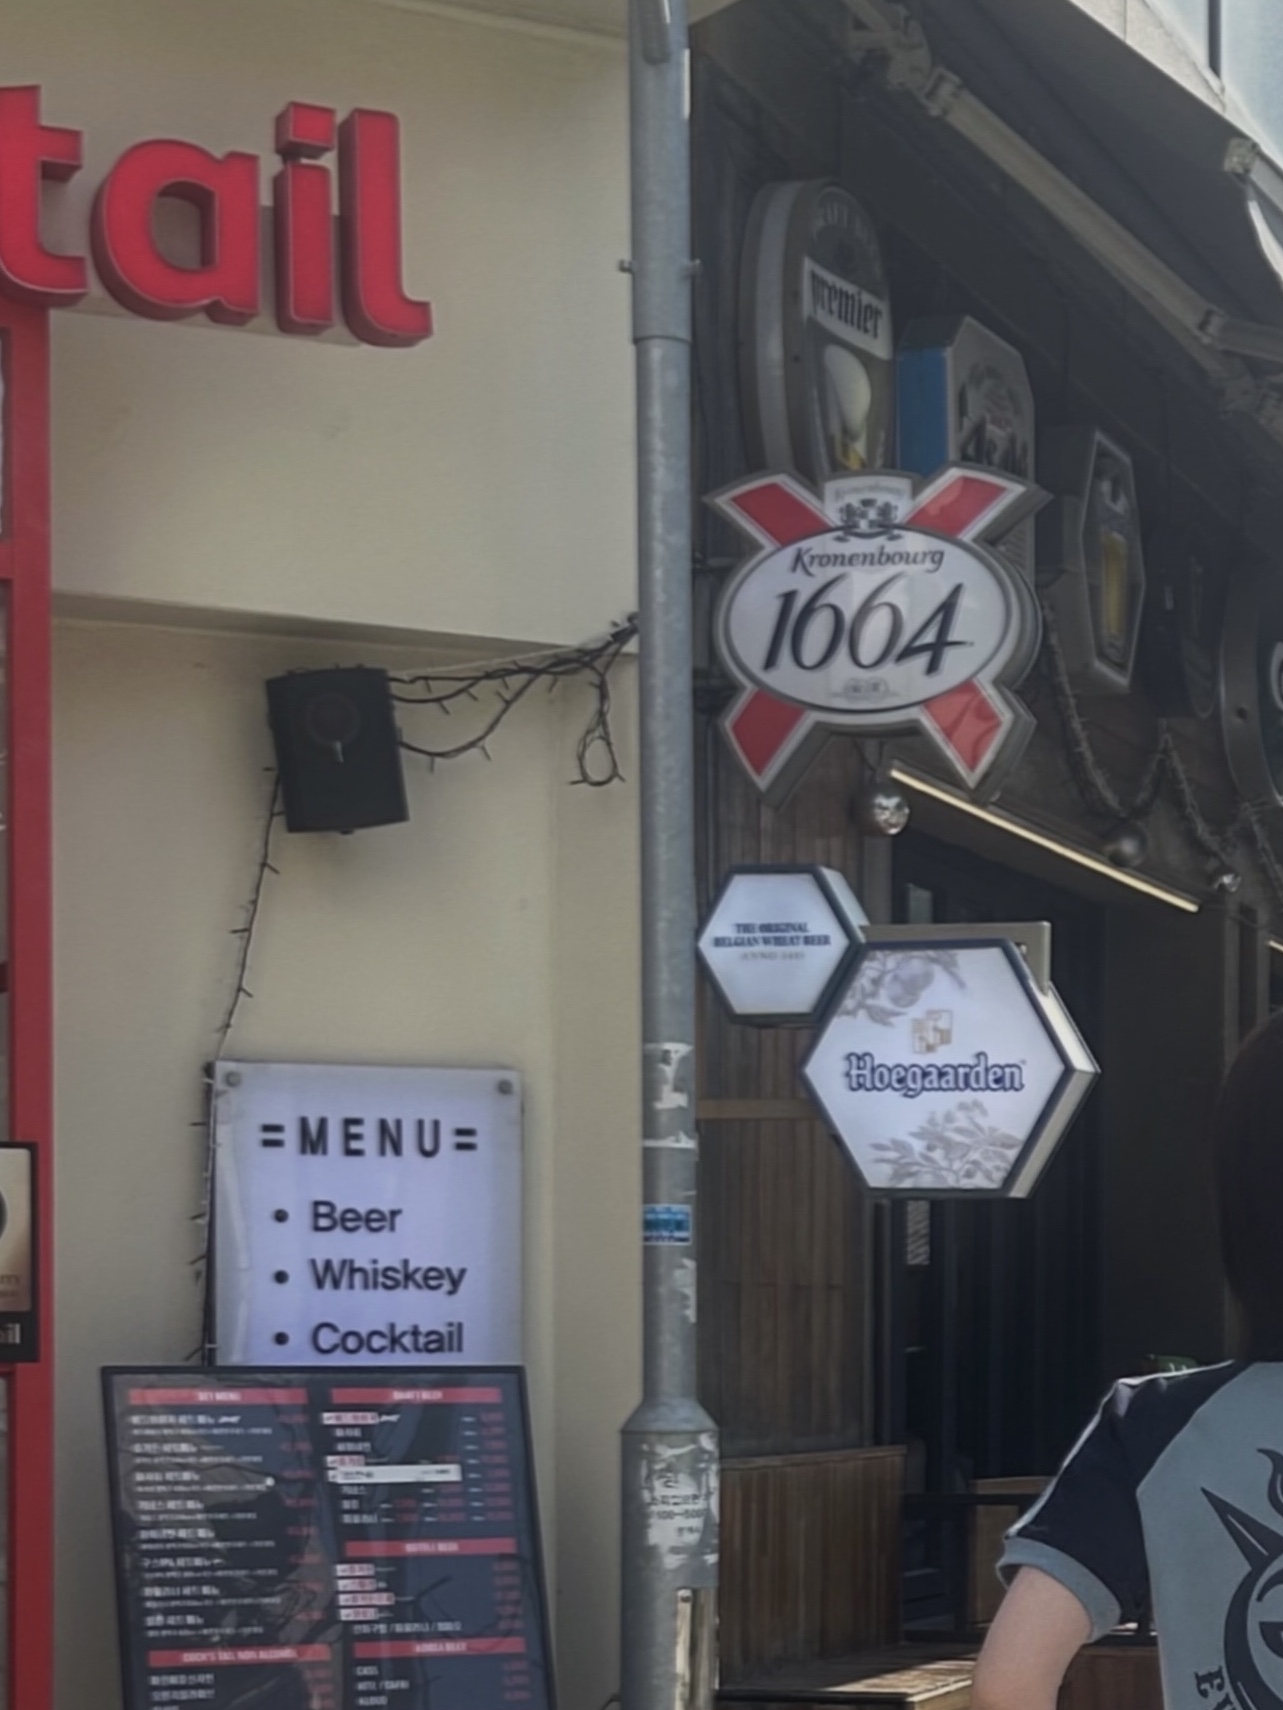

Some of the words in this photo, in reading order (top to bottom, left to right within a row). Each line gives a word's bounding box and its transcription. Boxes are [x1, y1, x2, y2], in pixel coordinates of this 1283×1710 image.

[0, 84, 433, 347] tail
[791, 546, 945, 578] Kronenbourg
[762, 572, 974, 677] 1664
[713, 936, 760, 947] BELGIAN
[761, 935, 802, 947] WHEAT
[803, 934, 831, 946] BEER
[734, 923, 756, 934] THE
[758, 922, 809, 933] ORIGINAL
[845, 1051, 1026, 1098] Hoegaarden
[311, 1200, 403, 1233] Beer
[311, 1259, 467, 1296] Whiskey
[311, 1322, 464, 1354] Cocktail
